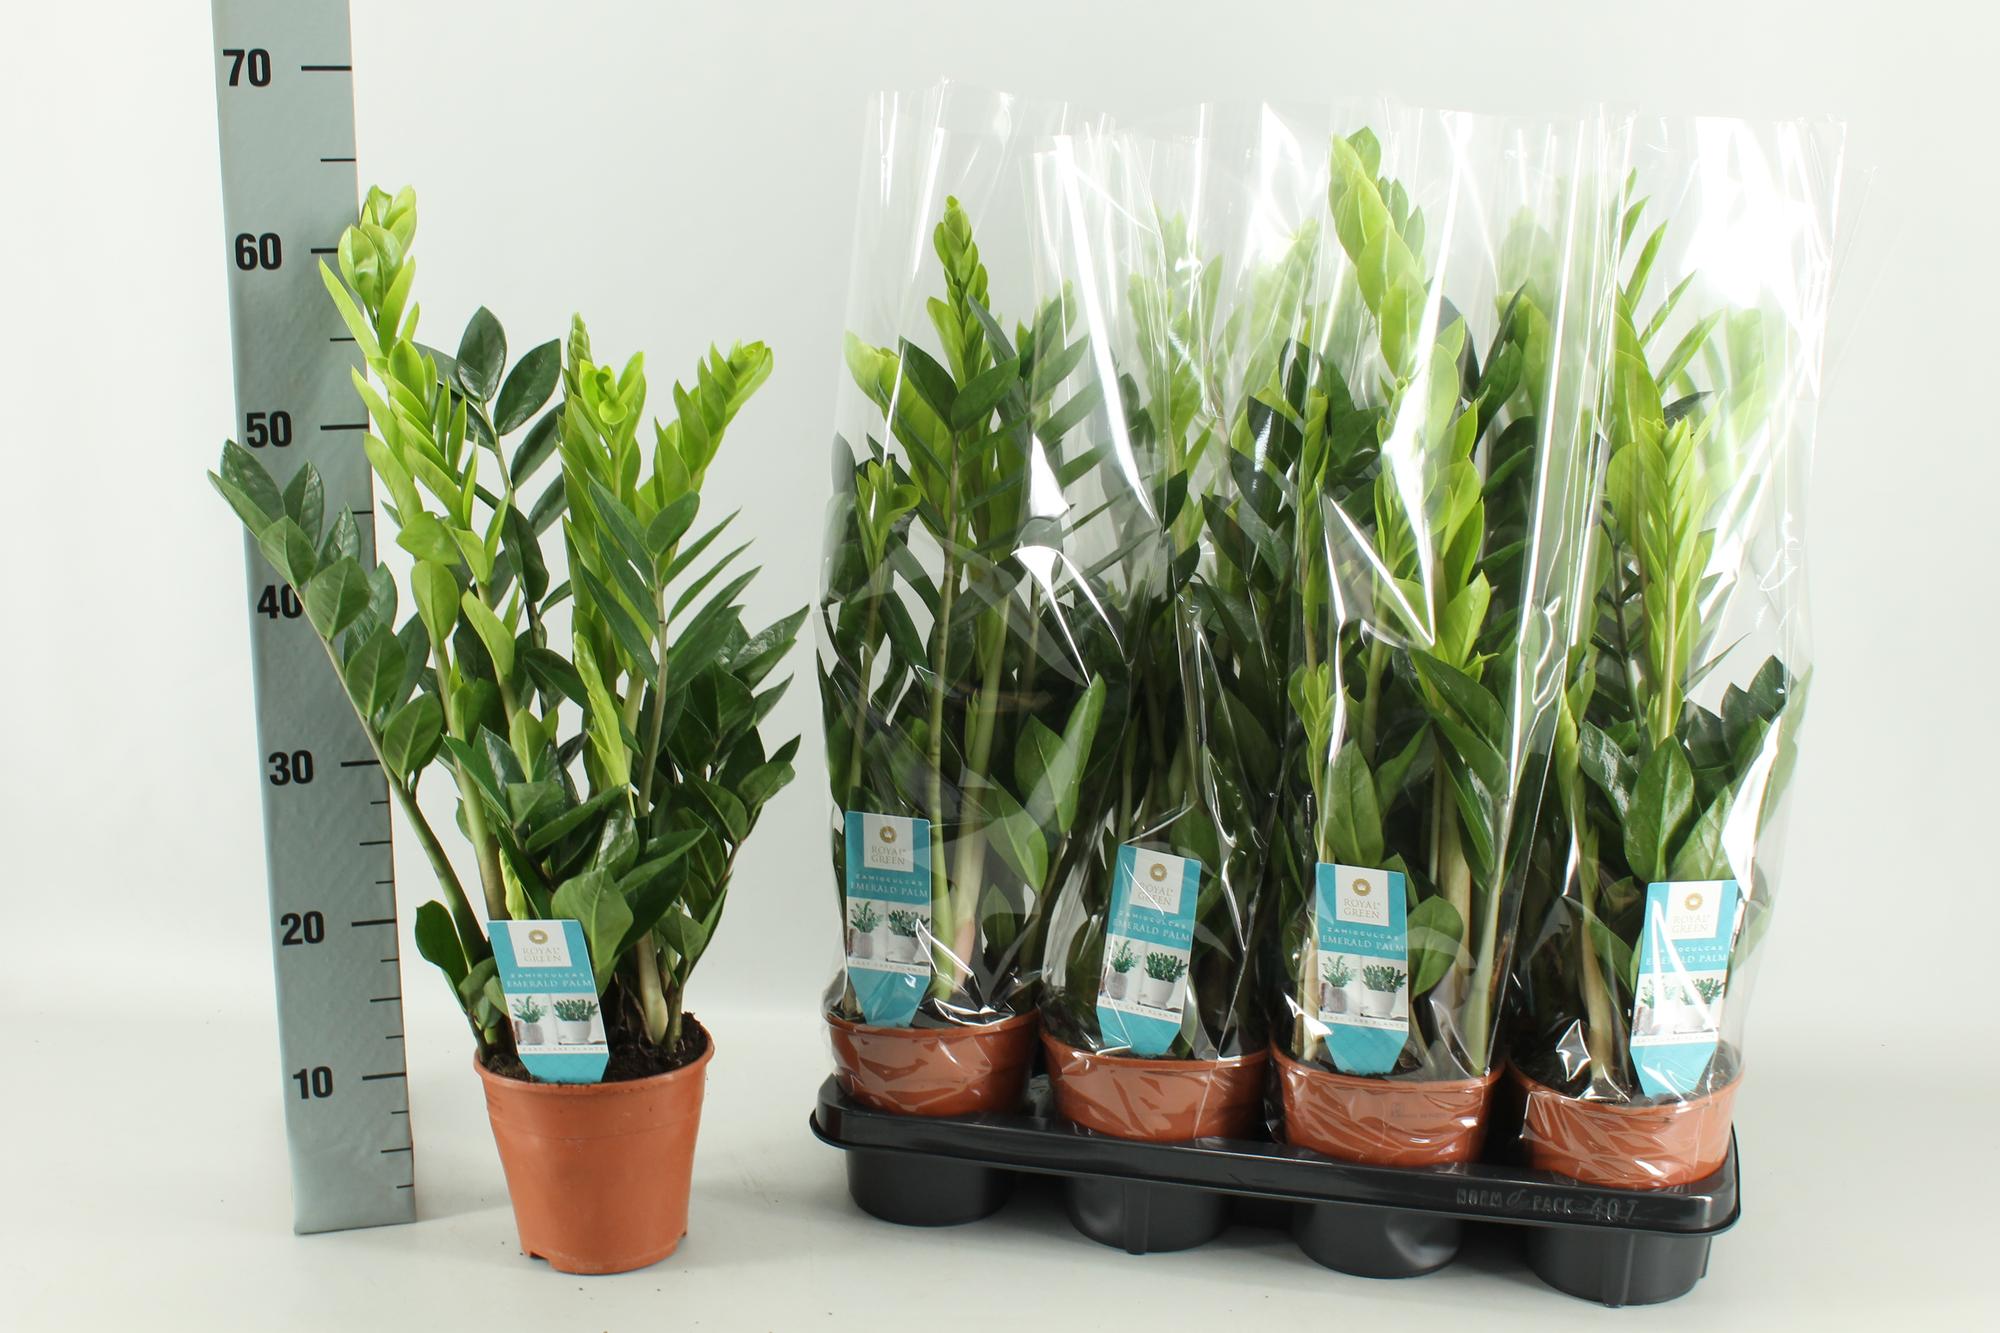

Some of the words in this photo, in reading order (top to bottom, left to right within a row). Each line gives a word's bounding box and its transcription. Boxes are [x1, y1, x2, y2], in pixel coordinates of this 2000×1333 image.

[223, 49, 271, 86] 70
[236, 233, 282, 270] 60
[247, 411, 292, 448] 50
[257, 584, 303, 619] 40
[268, 750, 313, 785] 30
[871, 855, 905, 865] GREEN
[850, 882, 897, 895] EMERALD
[901, 887, 928, 898] PALM
[1344, 898, 1379, 909] ROYAL
[1344, 907, 1380, 919] GREEN
[281, 911, 324, 945] 20
[1163, 929, 1190, 941] PALM
[1322, 935, 1372, 949] EMERALD
[1376, 942, 1404, 952] PALM
[1699, 952, 1726, 963] PALM
[507, 980, 558, 988] EMERALD
[563, 979, 592, 987] PALM
[293, 1067, 333, 1100] 10
